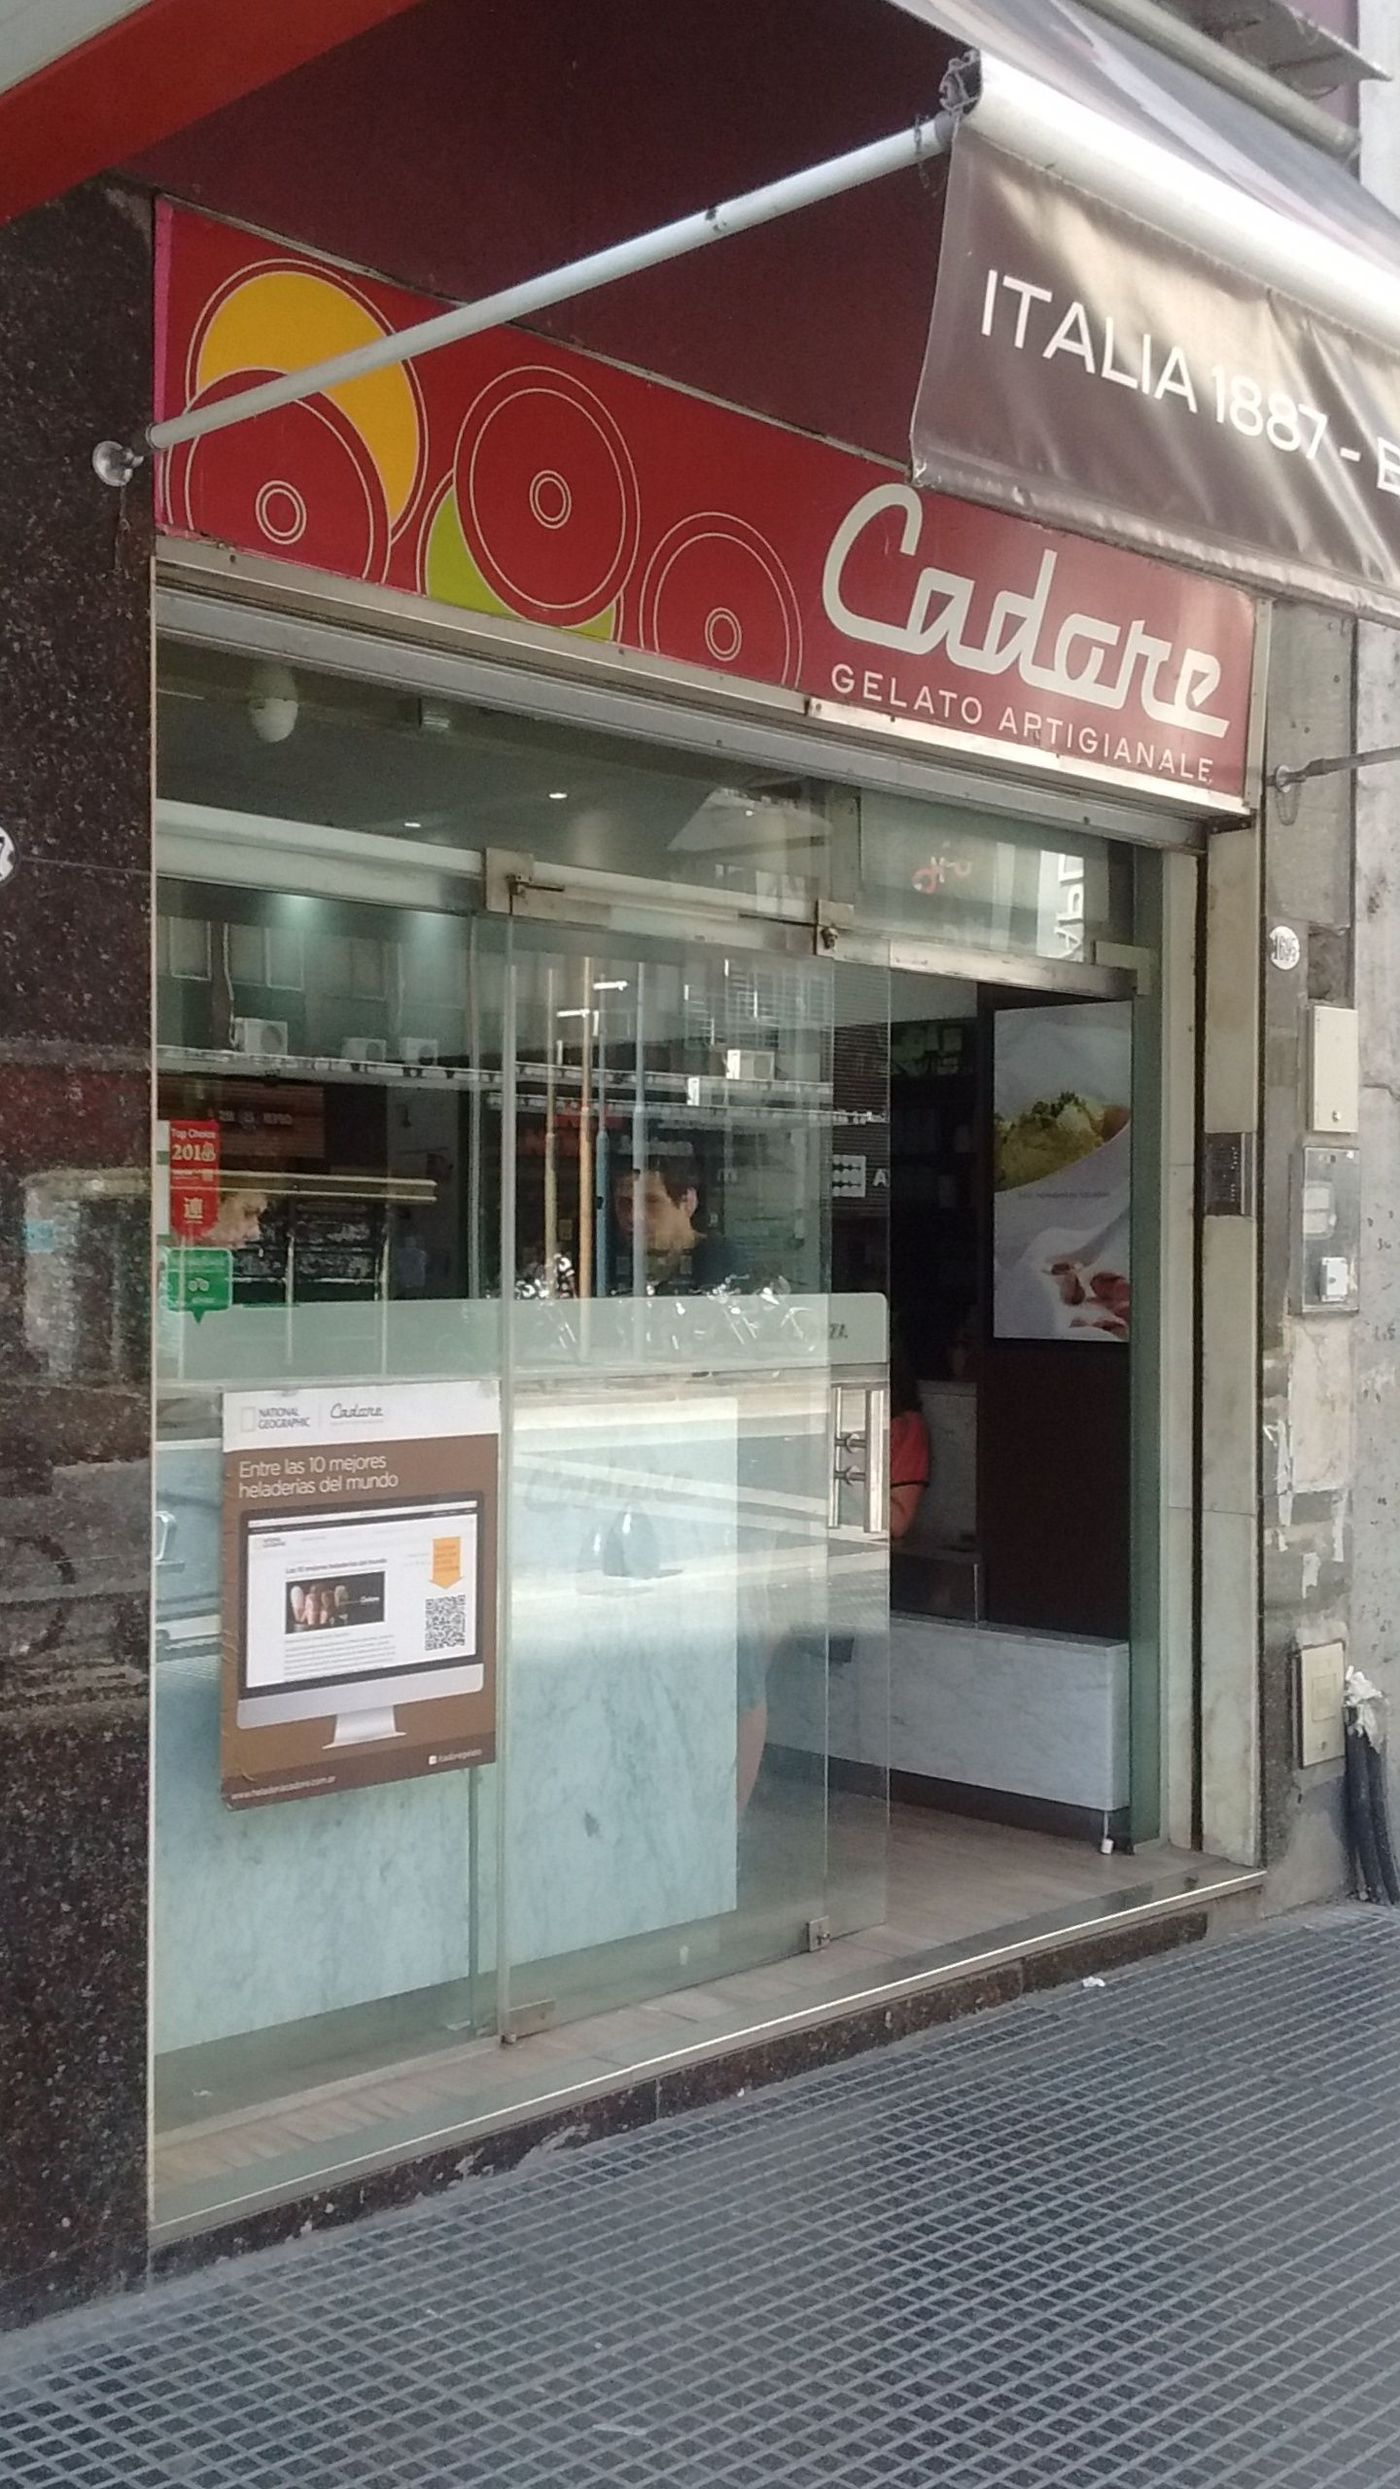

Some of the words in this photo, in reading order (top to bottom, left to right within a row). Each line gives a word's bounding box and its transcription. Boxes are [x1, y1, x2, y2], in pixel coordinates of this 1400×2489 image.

[980, 269, 1198, 414] ITALIA
[1210, 364, 1328, 461] 1887
[822, 482, 1230, 739] Cadore
[830, 663, 983, 725] GELATO
[998, 706, 1213, 786] ARTIGIANALE
[258, 1407, 300, 1419] NATIONAL
[330, 1402, 384, 1419] Cadore
[258, 1416, 311, 1430] GEOGRAPHIC
[239, 1460, 281, 1478] Entre
[284, 1458, 306, 1475] las
[309, 1456, 326, 1473] 10
[329, 1454, 386, 1474] mejores
[319, 1475, 343, 1493] del
[346, 1472, 399, 1491] mundo
